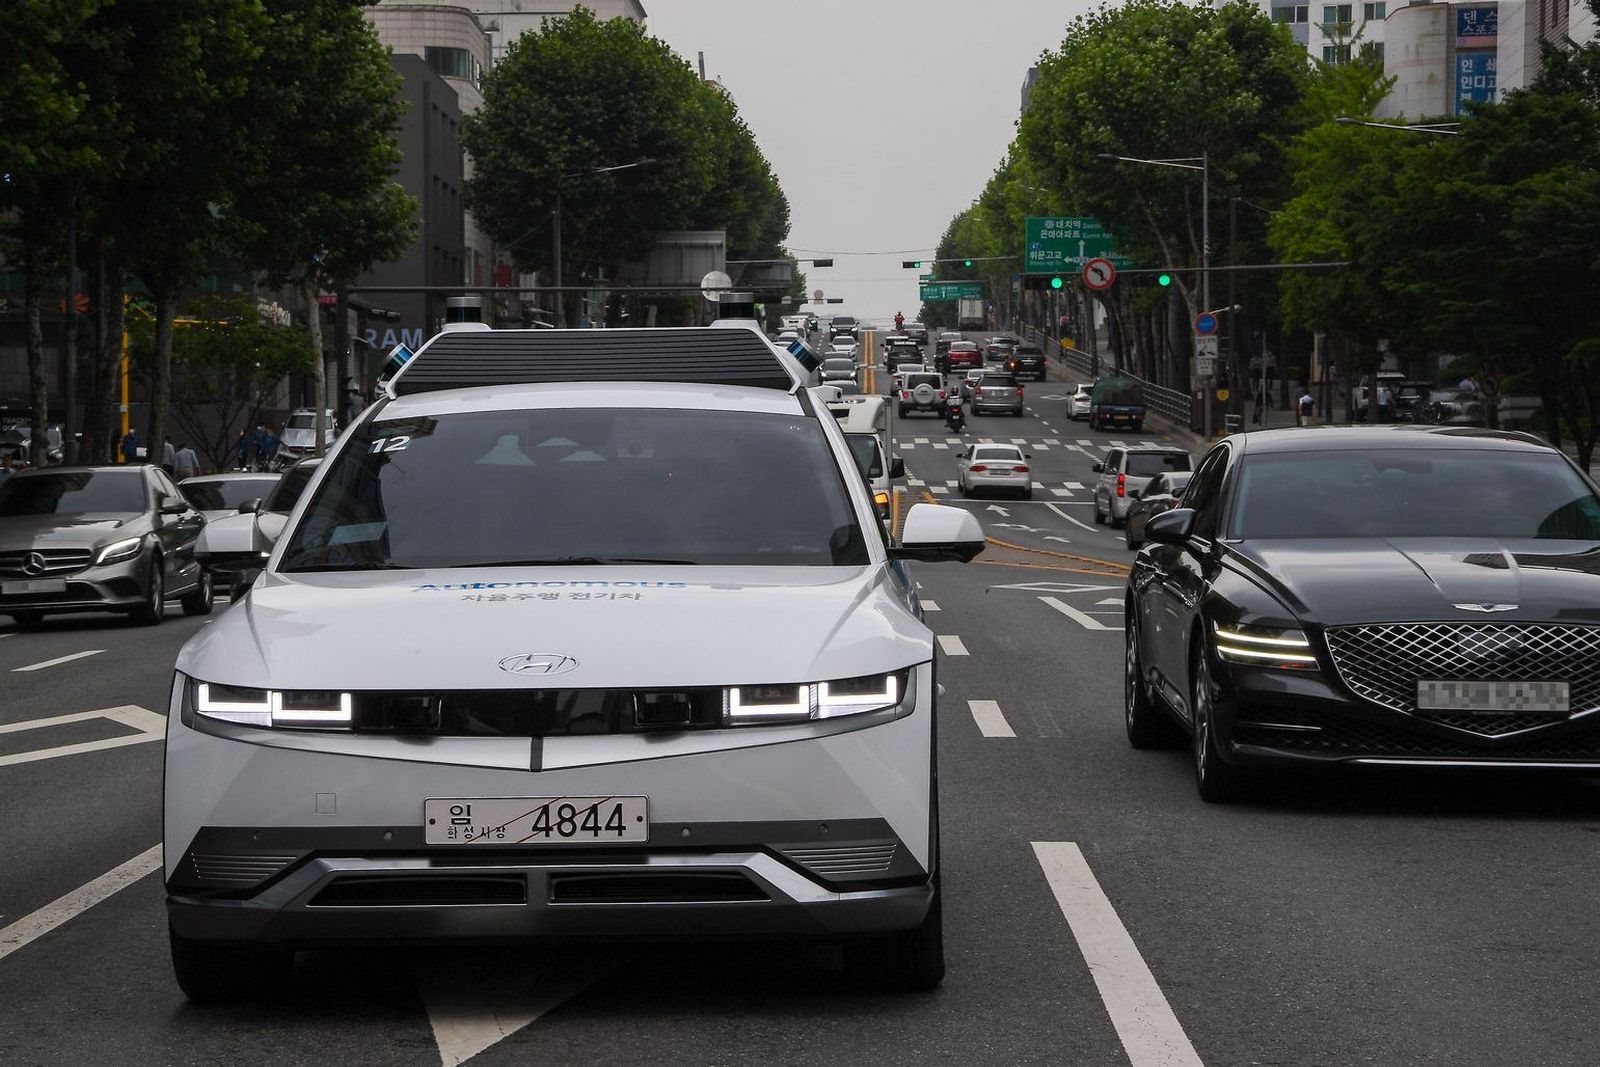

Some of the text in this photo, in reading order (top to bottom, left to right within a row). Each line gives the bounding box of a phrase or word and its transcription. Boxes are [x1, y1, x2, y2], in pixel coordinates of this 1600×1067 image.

[1056, 220, 1081, 229] 대치역
[372, 436, 410, 453] 12
[410, 581, 686, 592] Autonomous
[460, 592, 644, 602] 자율주행 전기차
[449, 803, 627, 838] 임 4844
